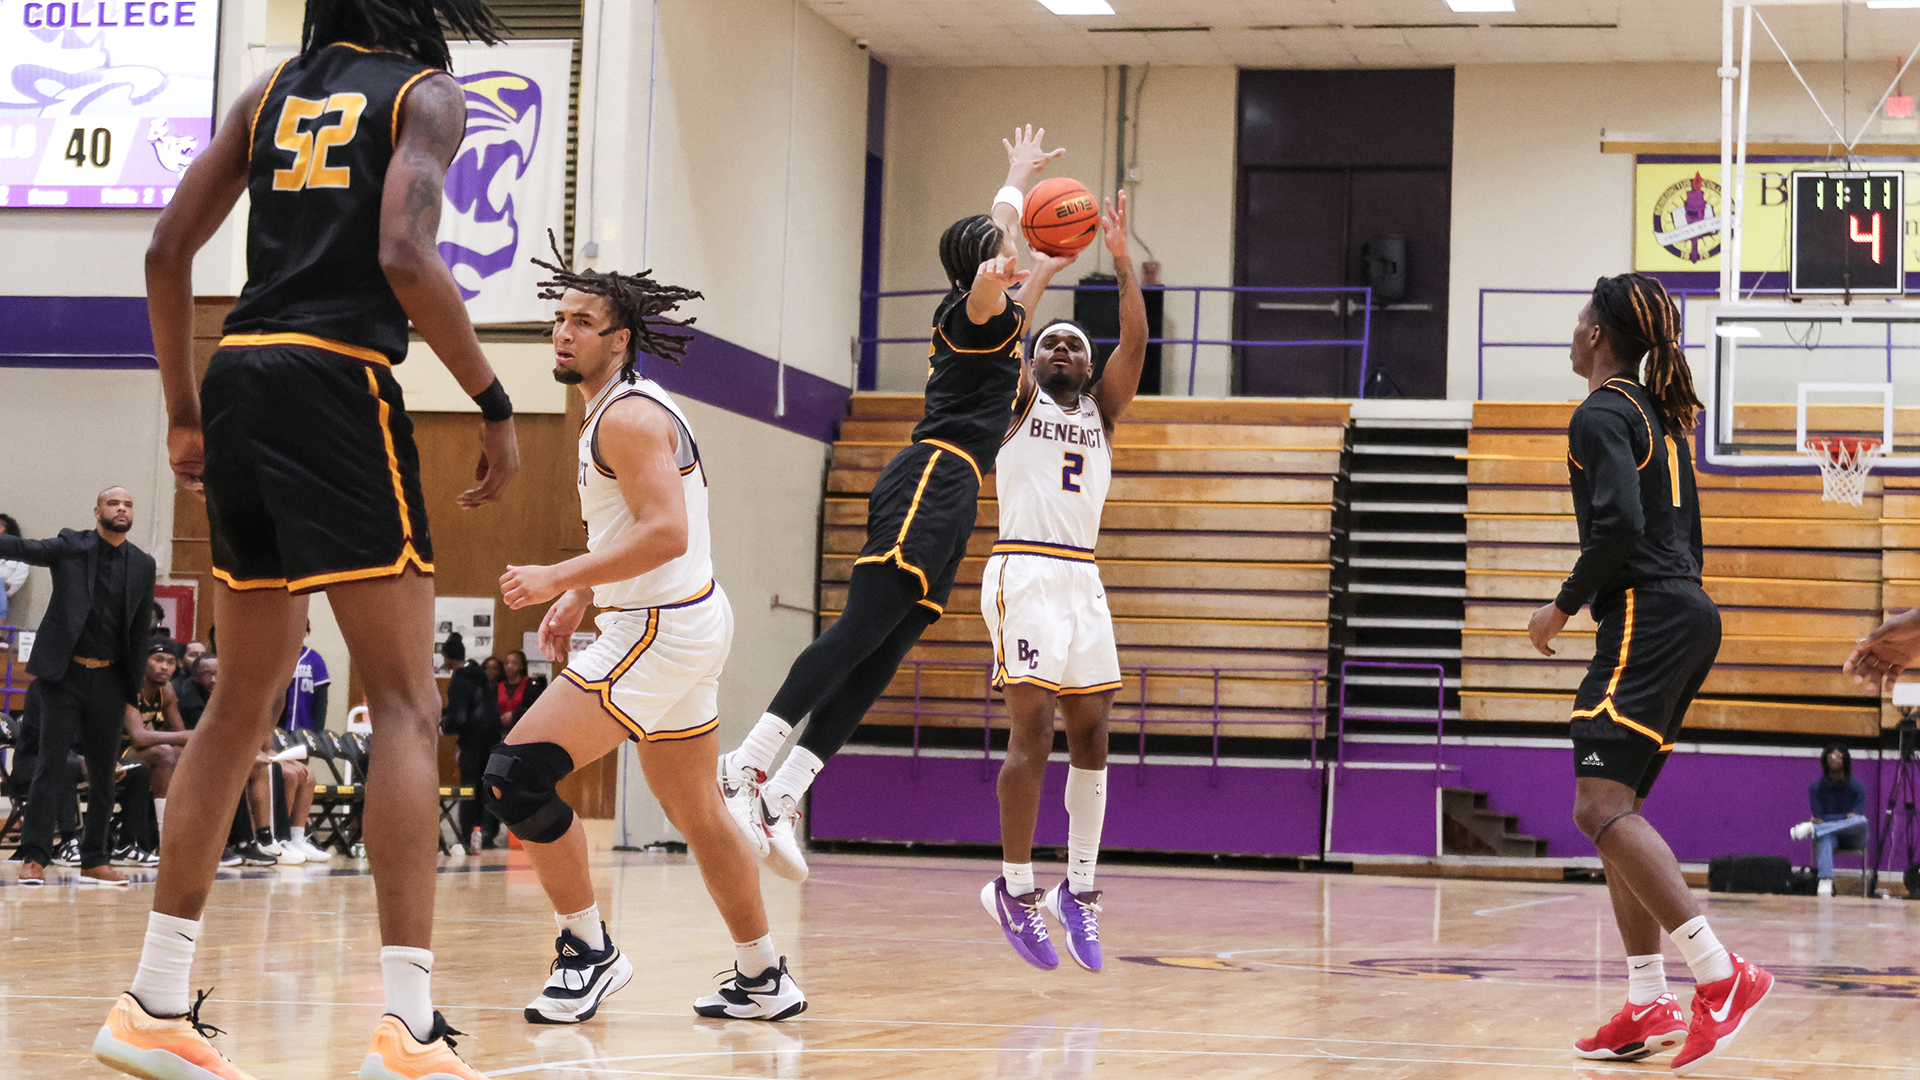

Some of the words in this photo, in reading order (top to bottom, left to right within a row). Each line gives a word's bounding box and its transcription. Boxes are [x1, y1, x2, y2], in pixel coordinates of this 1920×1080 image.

[23, 1, 197, 28] COLLEGE
[64, 127, 112, 169] 40
[272, 92, 367, 192] 52
[1055, 197, 1093, 219] ELITE
[1816, 179, 1891, 210] 11:11
[1849, 212, 1882, 264] 4
[1061, 450, 1085, 494] 2
[1664, 435, 1681, 507] 1
